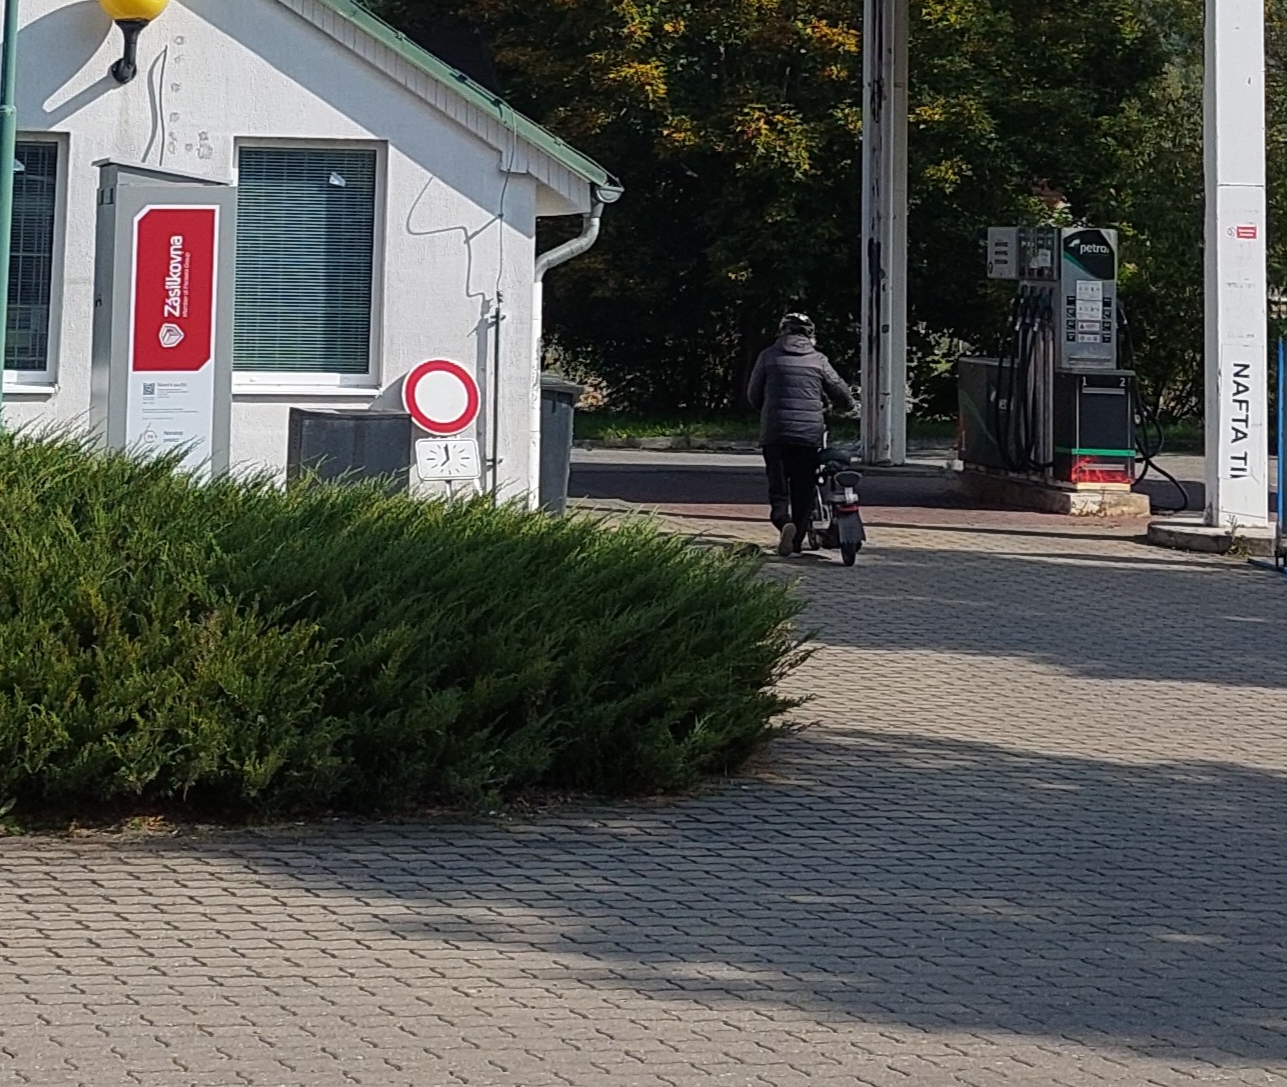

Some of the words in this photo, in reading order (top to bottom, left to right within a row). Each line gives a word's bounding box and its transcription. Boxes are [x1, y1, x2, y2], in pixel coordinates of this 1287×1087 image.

[164, 235, 184, 318] Zásilkovna
[1082, 376, 1088, 386] 1
[1119, 377, 1126, 387] 2
[1230, 363, 1250, 444] NAFTA
